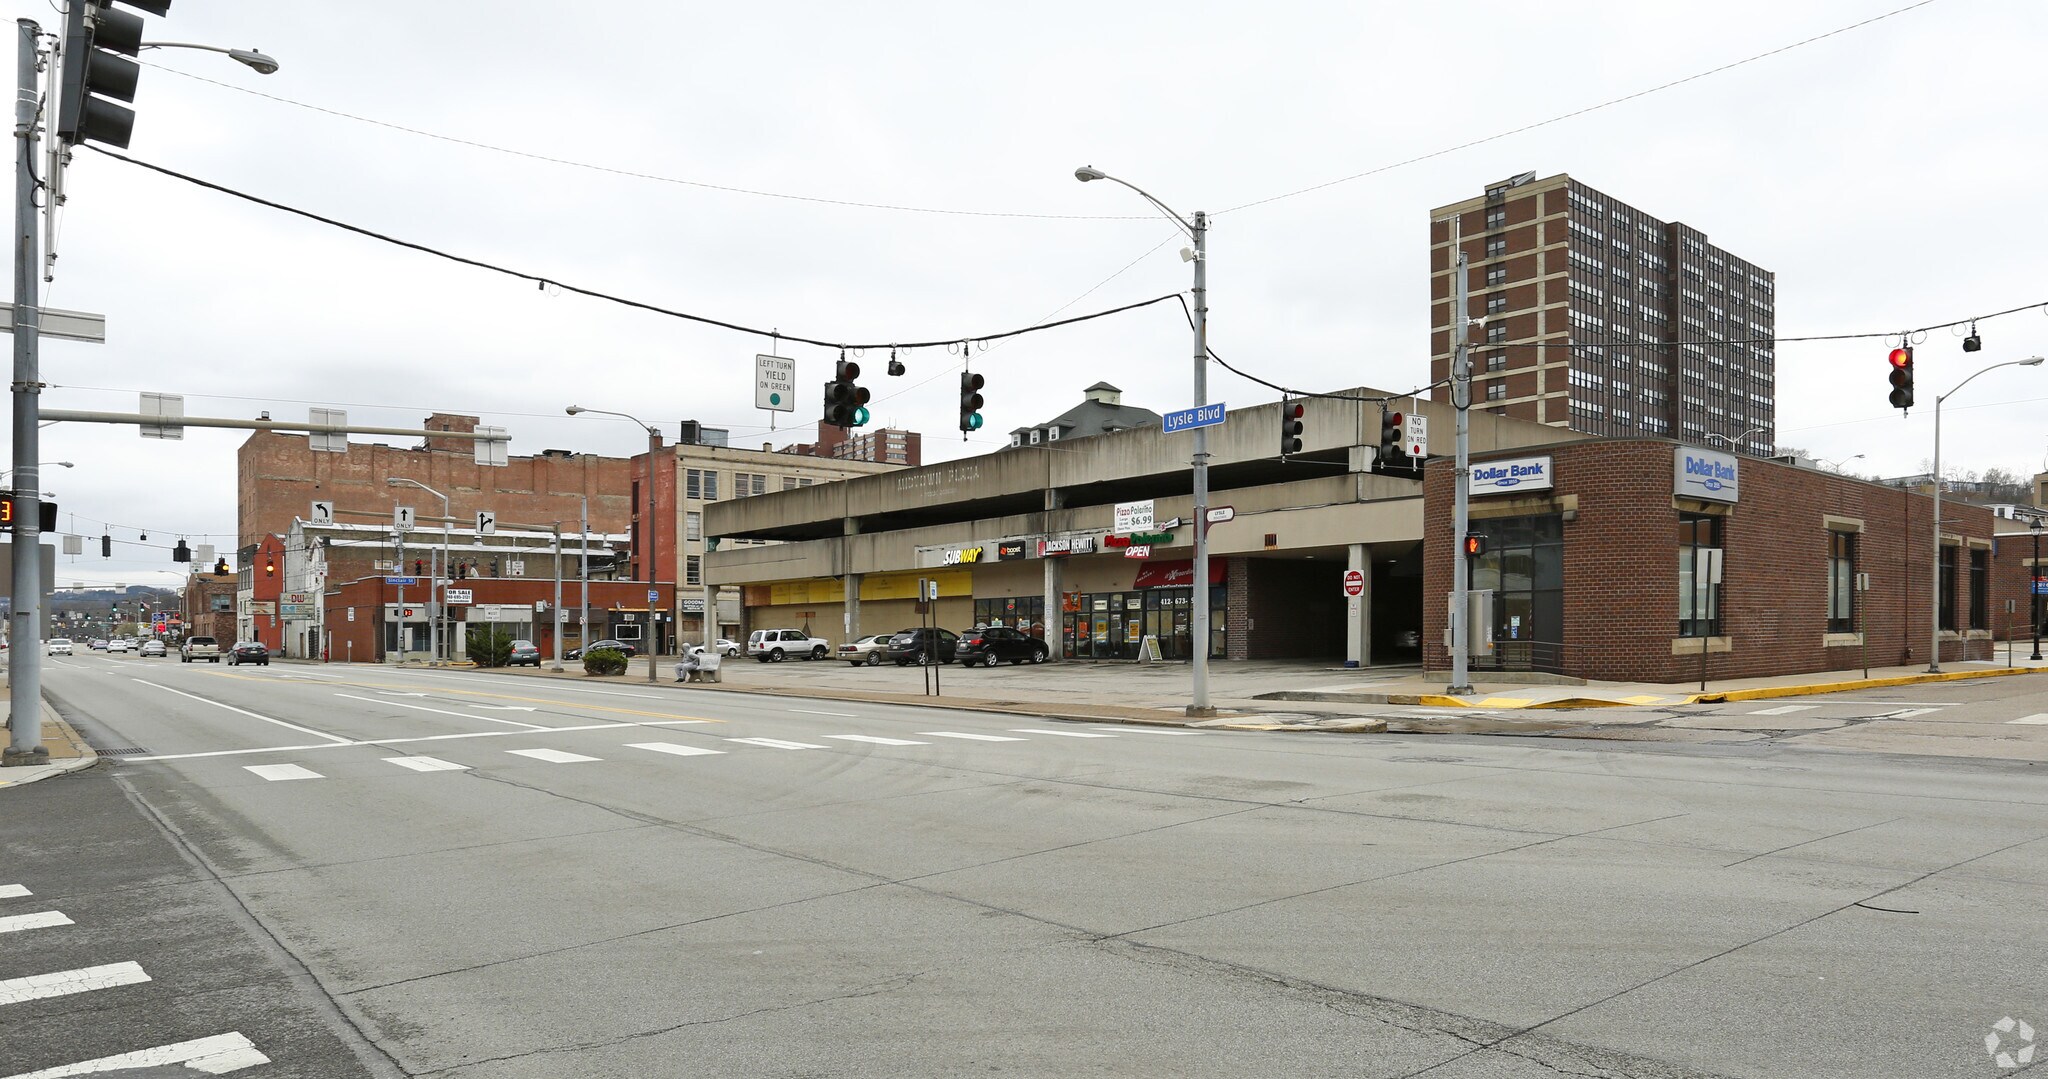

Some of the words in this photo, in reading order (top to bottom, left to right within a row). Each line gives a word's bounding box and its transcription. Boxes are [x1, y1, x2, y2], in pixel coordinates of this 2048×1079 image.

[760, 359, 774, 368] LEFT
[776, 361, 792, 370] TURN
[765, 370, 786, 381] YIELD
[760, 381, 769, 389] ON
[771, 382, 791, 391] GREEN
[1168, 412, 1193, 430] Lysle
[1198, 405, 1220, 422] Blvd
[1411, 417, 1422, 426] NO
[1410, 427, 1424, 435] TURN
[1407, 435, 1415, 443] ON
[1416, 436, 1427, 444] RED
[949, 466, 979, 482] PLAZA
[1474, 467, 1508, 481] Dollar
[1511, 463, 1543, 477] Bank
[1686, 456, 1714, 477] Dollar
[1715, 460, 1735, 481] Bank
[1, 501, 10, 521] 3
[1116, 507, 1130, 517] Pizza
[1131, 515, 1152, 526] $6.99
[1046, 539, 1070, 551] JACKSON
[1071, 537, 1094, 550] HEWITT
[943, 547, 982, 565] SUBWAY
[1125, 545, 1150, 557] OPEN
[291, 594, 305, 603] DW
